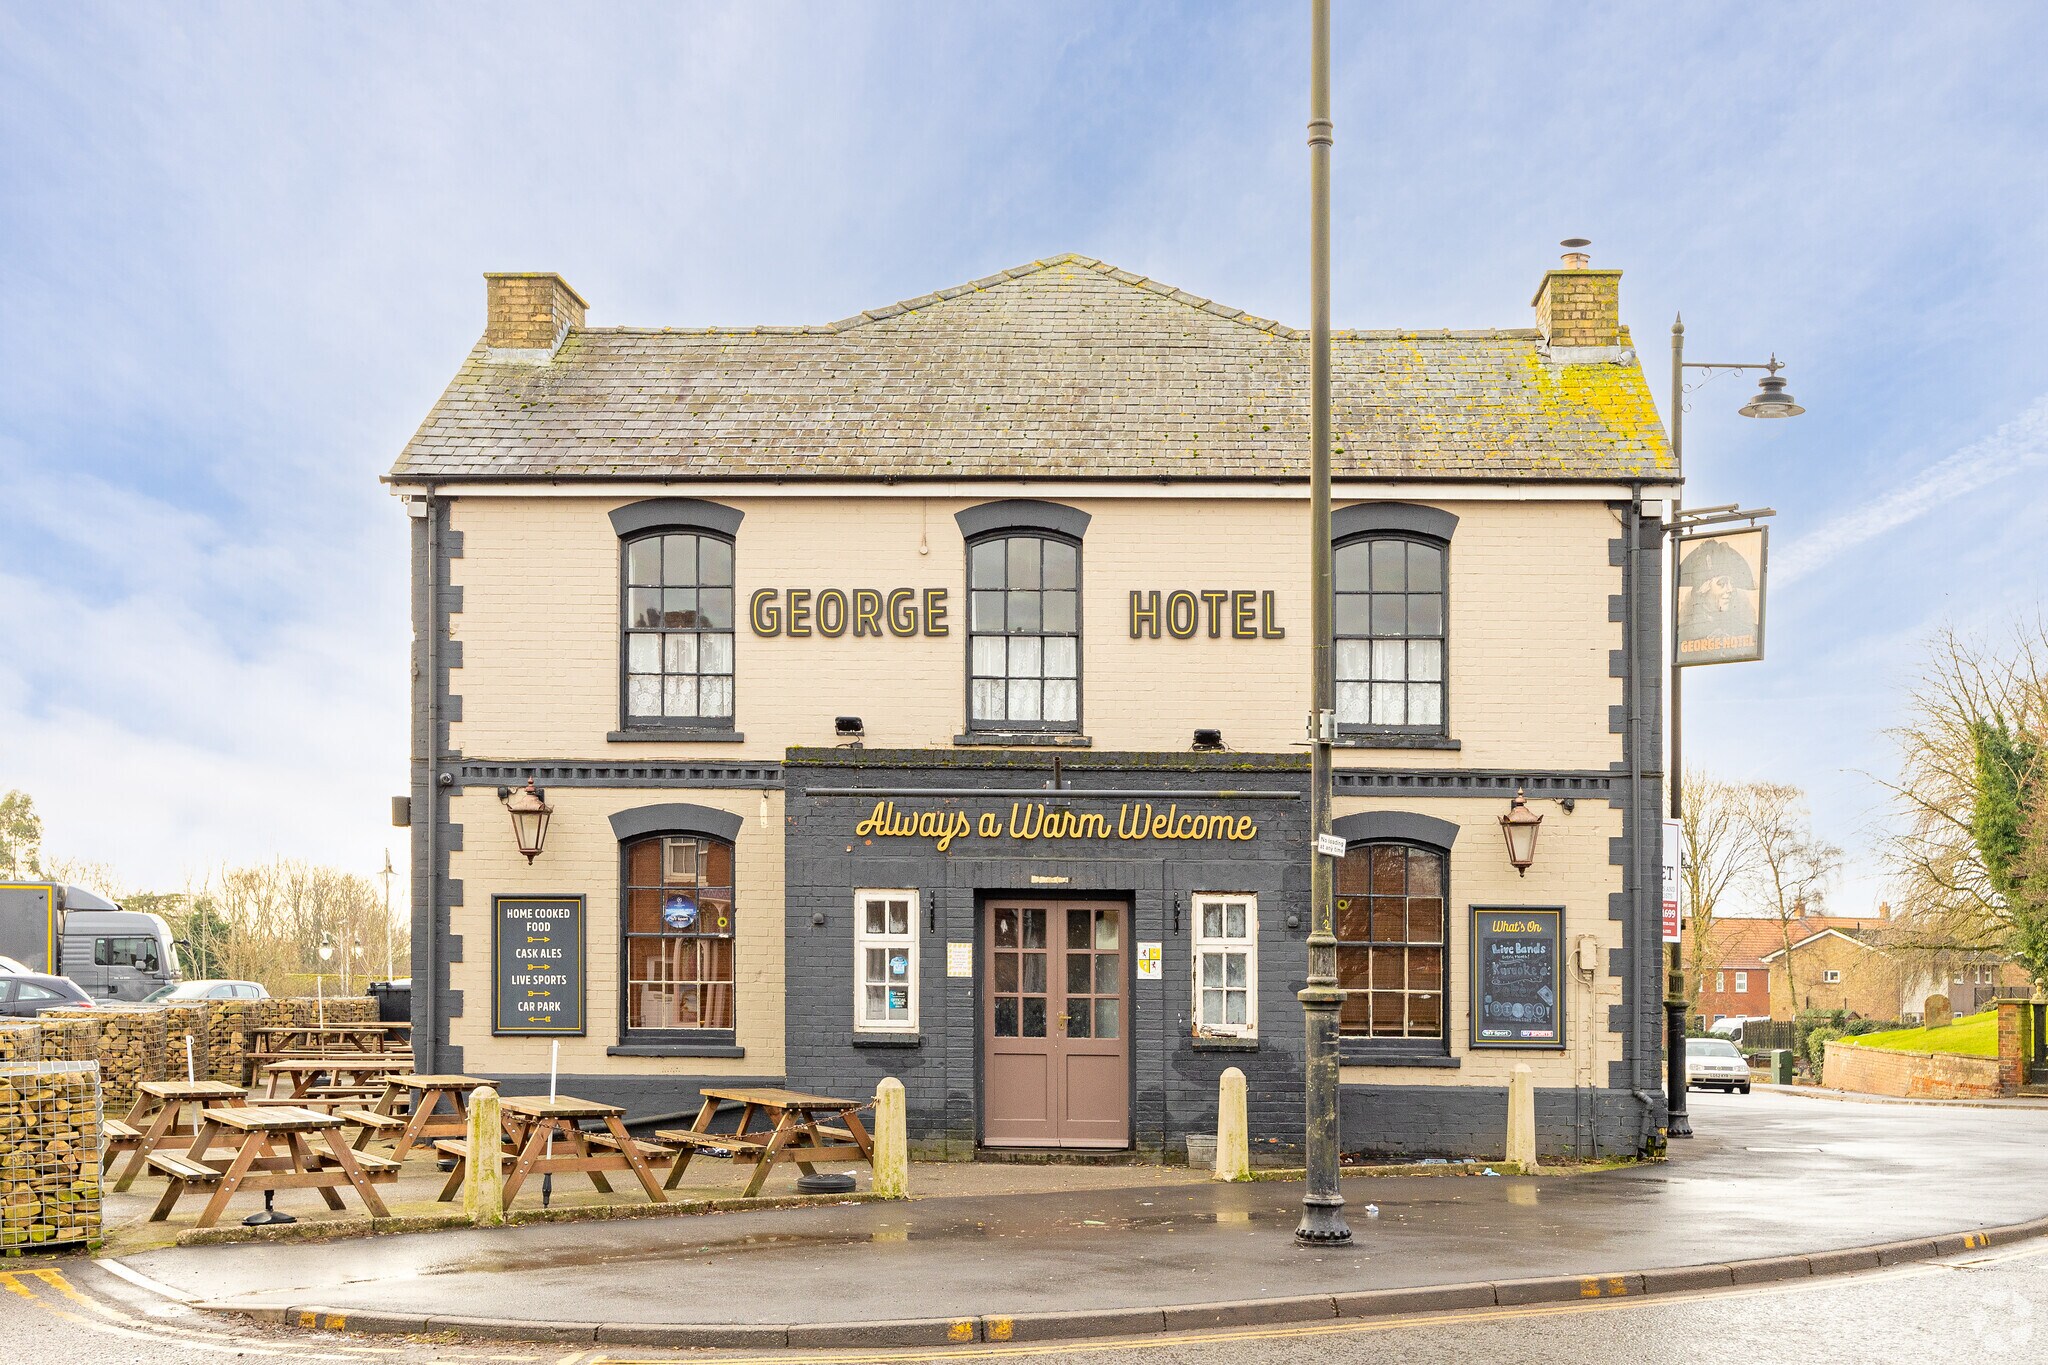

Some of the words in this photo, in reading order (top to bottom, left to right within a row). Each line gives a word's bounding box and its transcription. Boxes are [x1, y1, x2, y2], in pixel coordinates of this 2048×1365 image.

[750, 588, 949, 638] GEORGE
[1130, 590, 1285, 639] HOTEL
[1681, 637, 1721, 653] GEORGE
[1722, 635, 1754, 648] HOTEL
[855, 801, 971, 852] Always
[978, 813, 1002, 837] a
[1009, 803, 1112, 839] Warm
[1118, 803, 1257, 840] Welcome
[1328, 839, 1344, 848] loading
[1662, 866, 1674, 881] ET
[507, 908, 533, 919] HOME
[534, 908, 571, 919] COOKED
[526, 922, 551, 932] FOOD
[1492, 920, 1526, 932] What's
[1526, 920, 1542, 932] On
[515, 948, 539, 959] CASK
[540, 948, 562, 959] ALES
[1491, 943, 1514, 954] Live
[1515, 942, 1546, 954] Bands
[511, 975, 531, 985] LIVE
[533, 975, 567, 985] SPORTS
[517, 1001, 535, 1012] CAR
[537, 1001, 561, 1012] PARK
